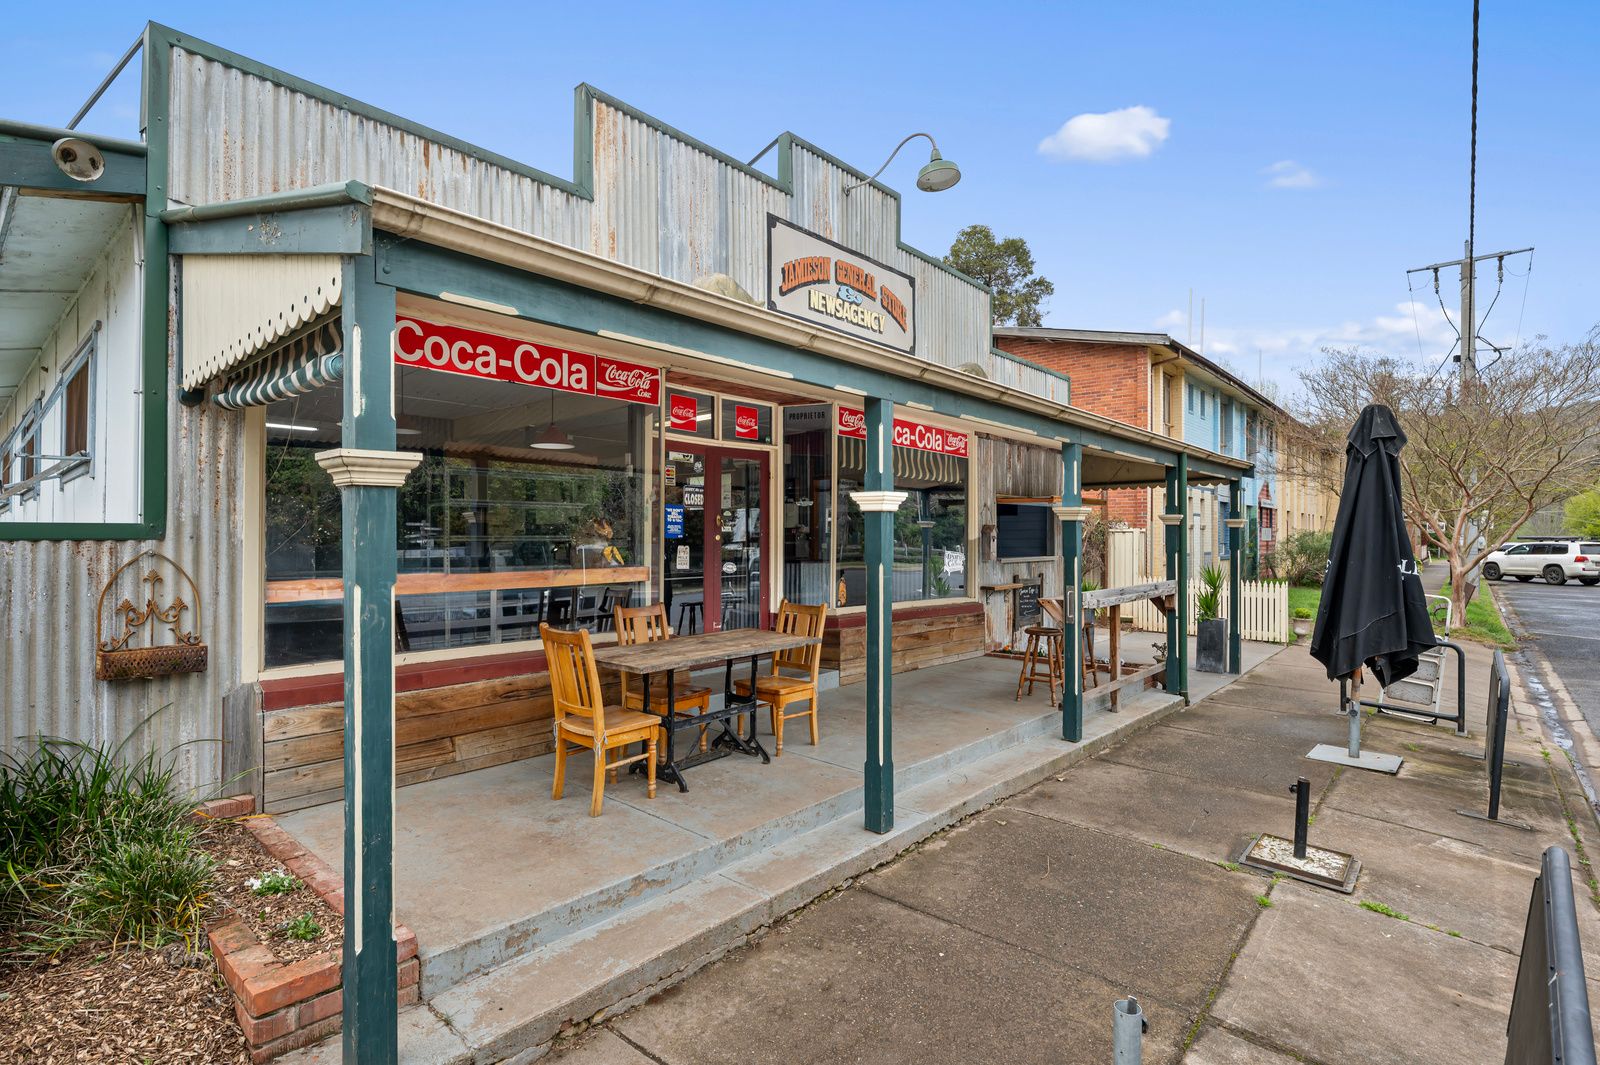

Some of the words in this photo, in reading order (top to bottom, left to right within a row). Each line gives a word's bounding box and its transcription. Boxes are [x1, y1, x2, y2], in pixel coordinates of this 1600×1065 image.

[780, 256, 831, 296] JAMIESON
[835, 260, 878, 302] GENERAL
[880, 284, 908, 333] STORE
[808, 289, 886, 334] NEWSAGENCY
[395, 320, 588, 390] Coca-Cola
[605, 364, 652, 390] Coca-Cola
[789, 411, 826, 421] PROPRIETOR
[894, 424, 942, 451] ca-Cola
[684, 493, 704, 505] CLOSED
